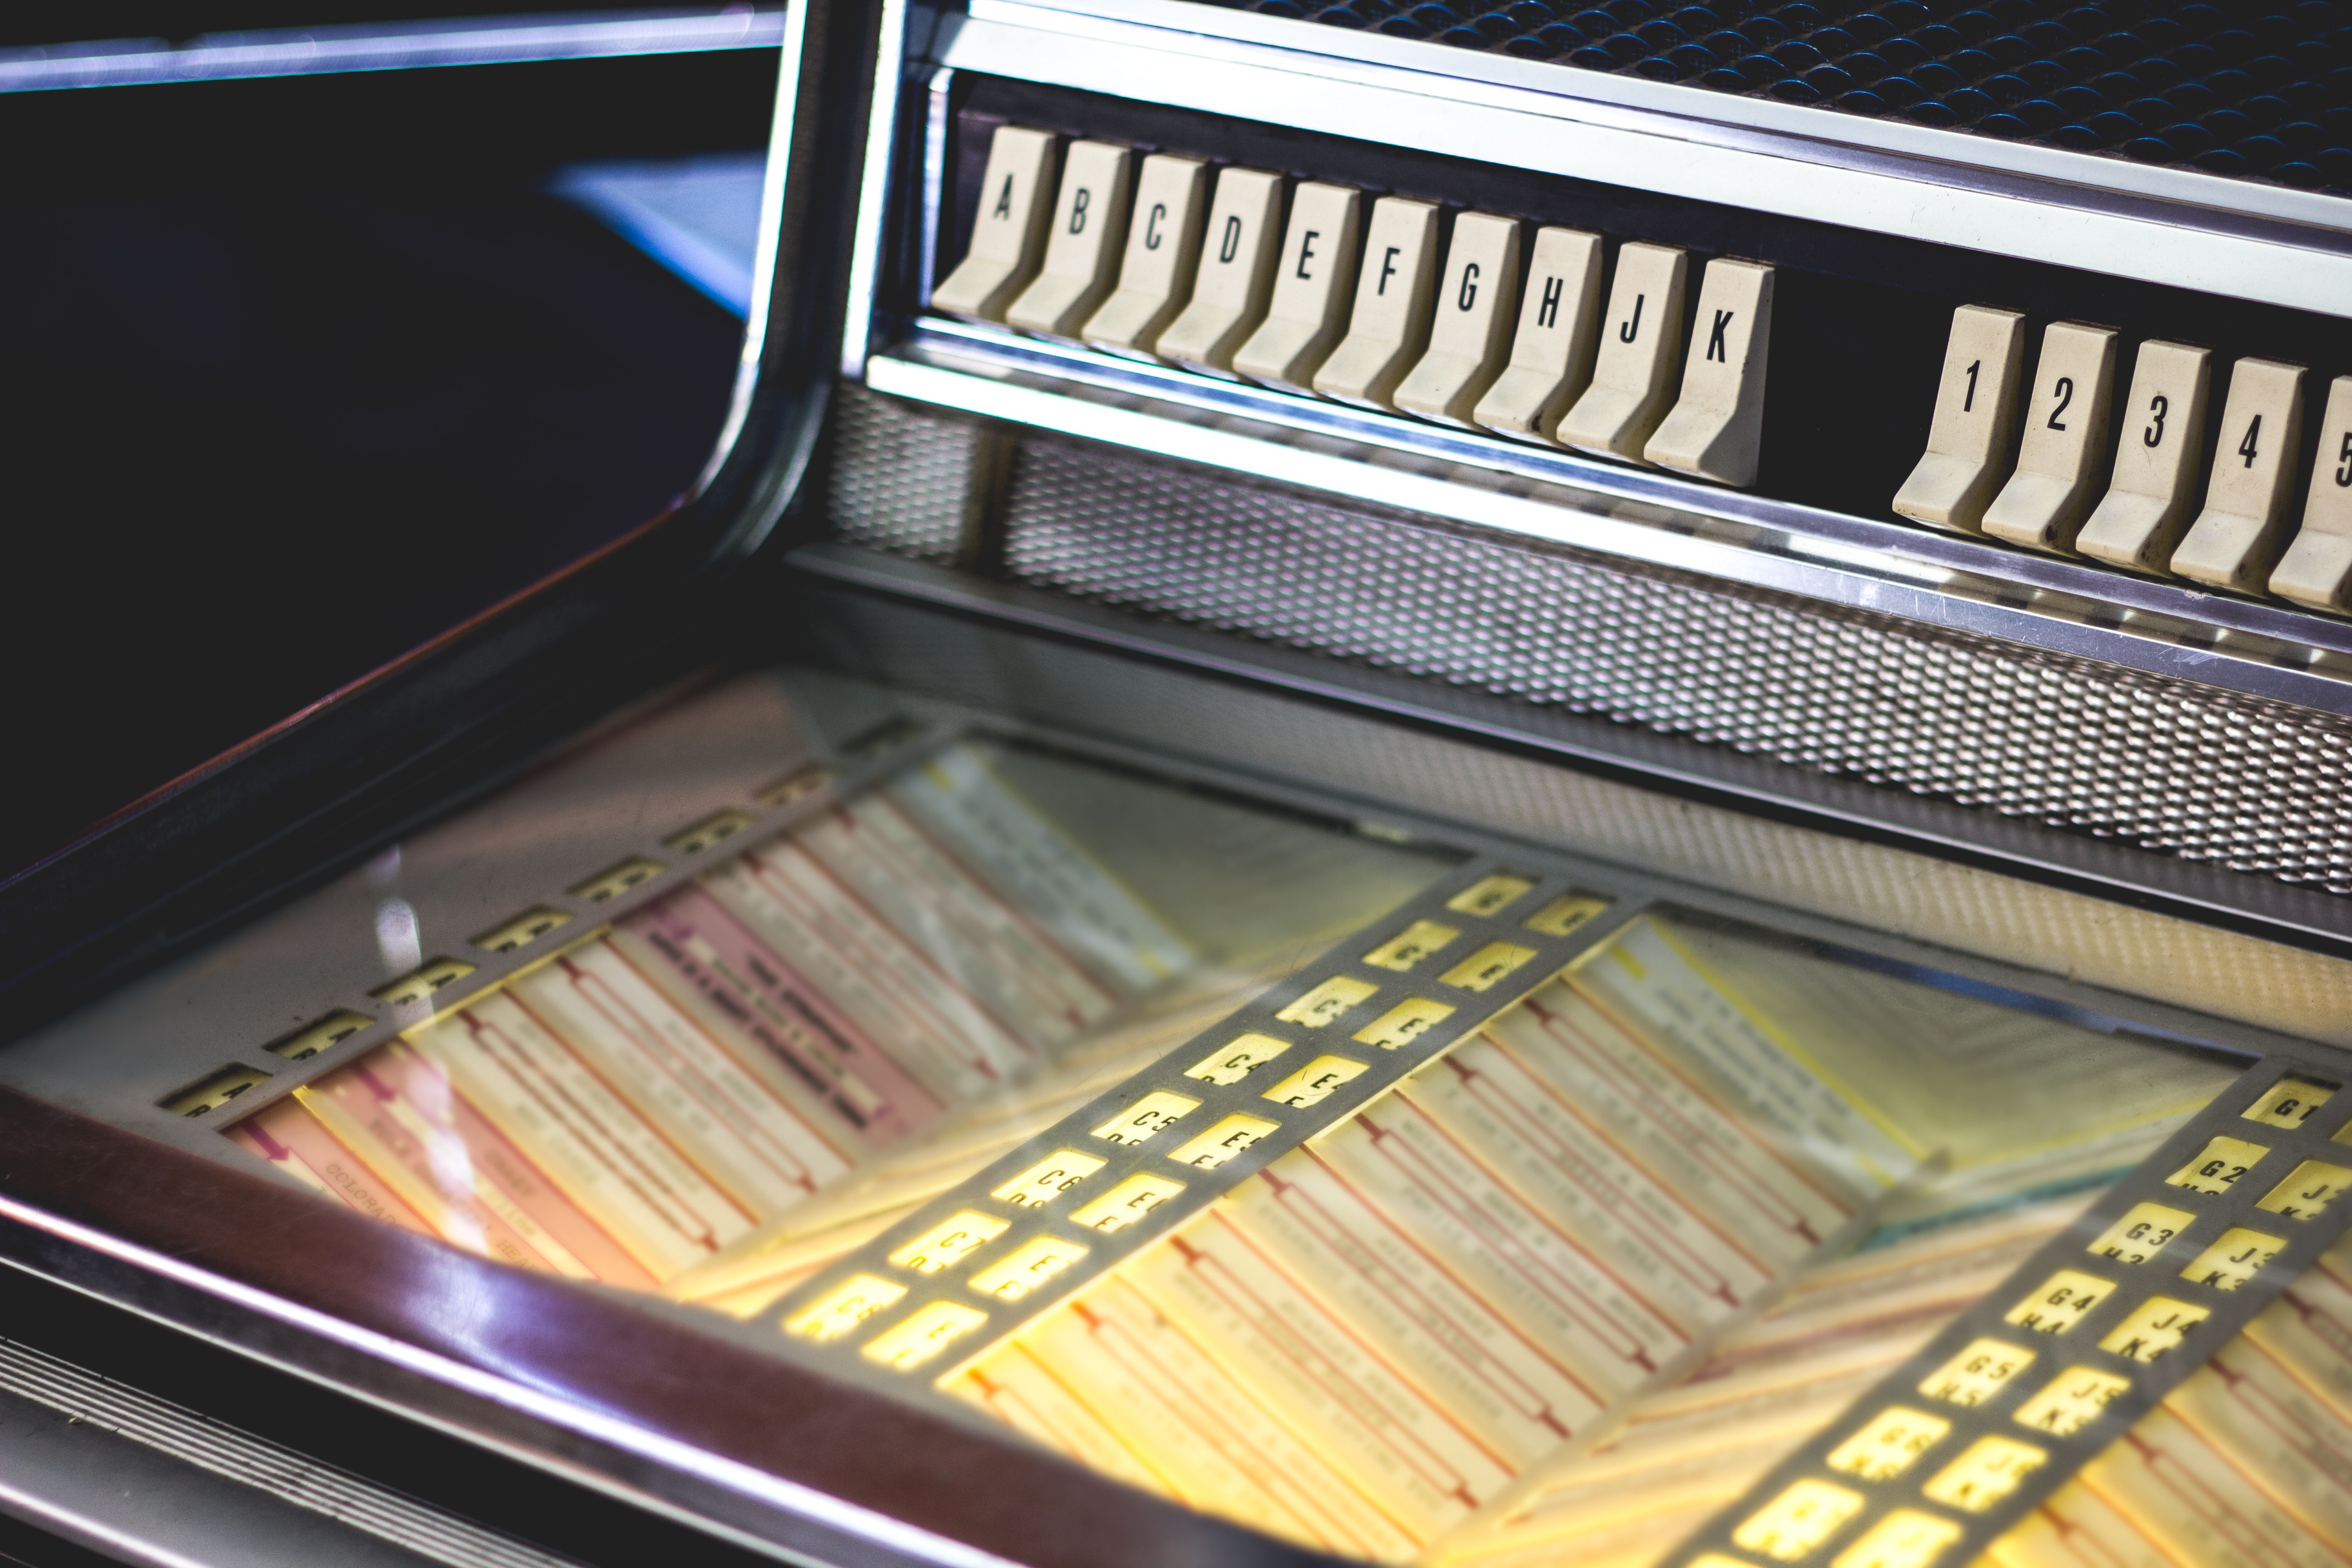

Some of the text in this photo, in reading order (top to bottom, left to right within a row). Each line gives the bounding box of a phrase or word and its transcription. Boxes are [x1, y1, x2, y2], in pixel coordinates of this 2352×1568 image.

[995, 174, 1013, 218] A
[1069, 188, 1089, 235] B
[1145, 203, 1166, 251] C
[1220, 216, 1241, 264] D
[1297, 230, 1320, 280] E
[1378, 247, 1400, 296] F
[1458, 262, 1480, 312] G
[1538, 276, 1563, 328] H
[1620, 294, 1644, 343] J
[1707, 309, 1734, 363] K
[1964, 359, 1981, 412] 1
[2047, 377, 2073, 431] 2
[2144, 395, 2168, 448] 3
[2238, 414, 2262, 468] 4
[2199, 1160, 2248, 1184] G2
[2125, 1223, 2174, 1246] G3
